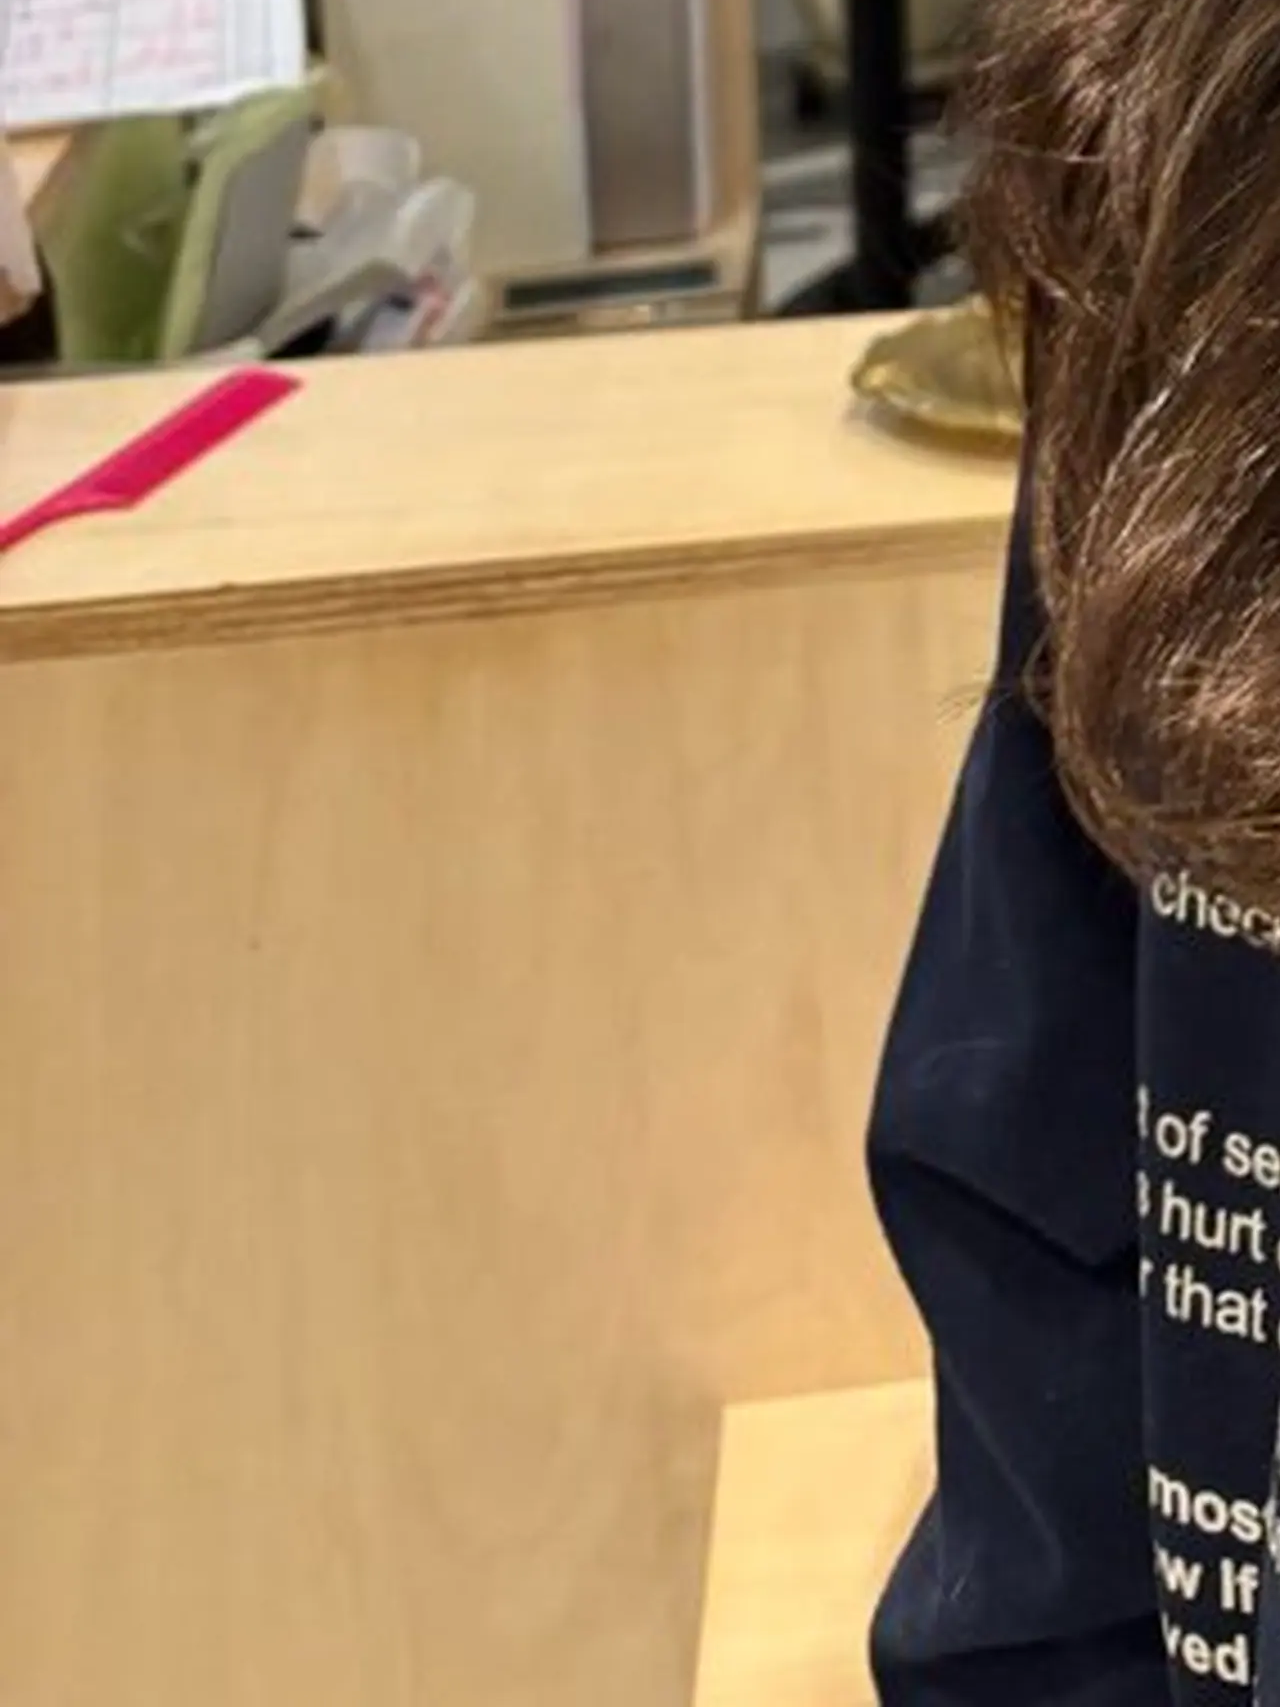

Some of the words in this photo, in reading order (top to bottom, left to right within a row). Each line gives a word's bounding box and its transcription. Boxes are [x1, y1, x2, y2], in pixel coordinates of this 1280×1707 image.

[1156, 1110, 1212, 1165] of
[1160, 1180, 1267, 1264] hurt
[1164, 1262, 1267, 1343] that
